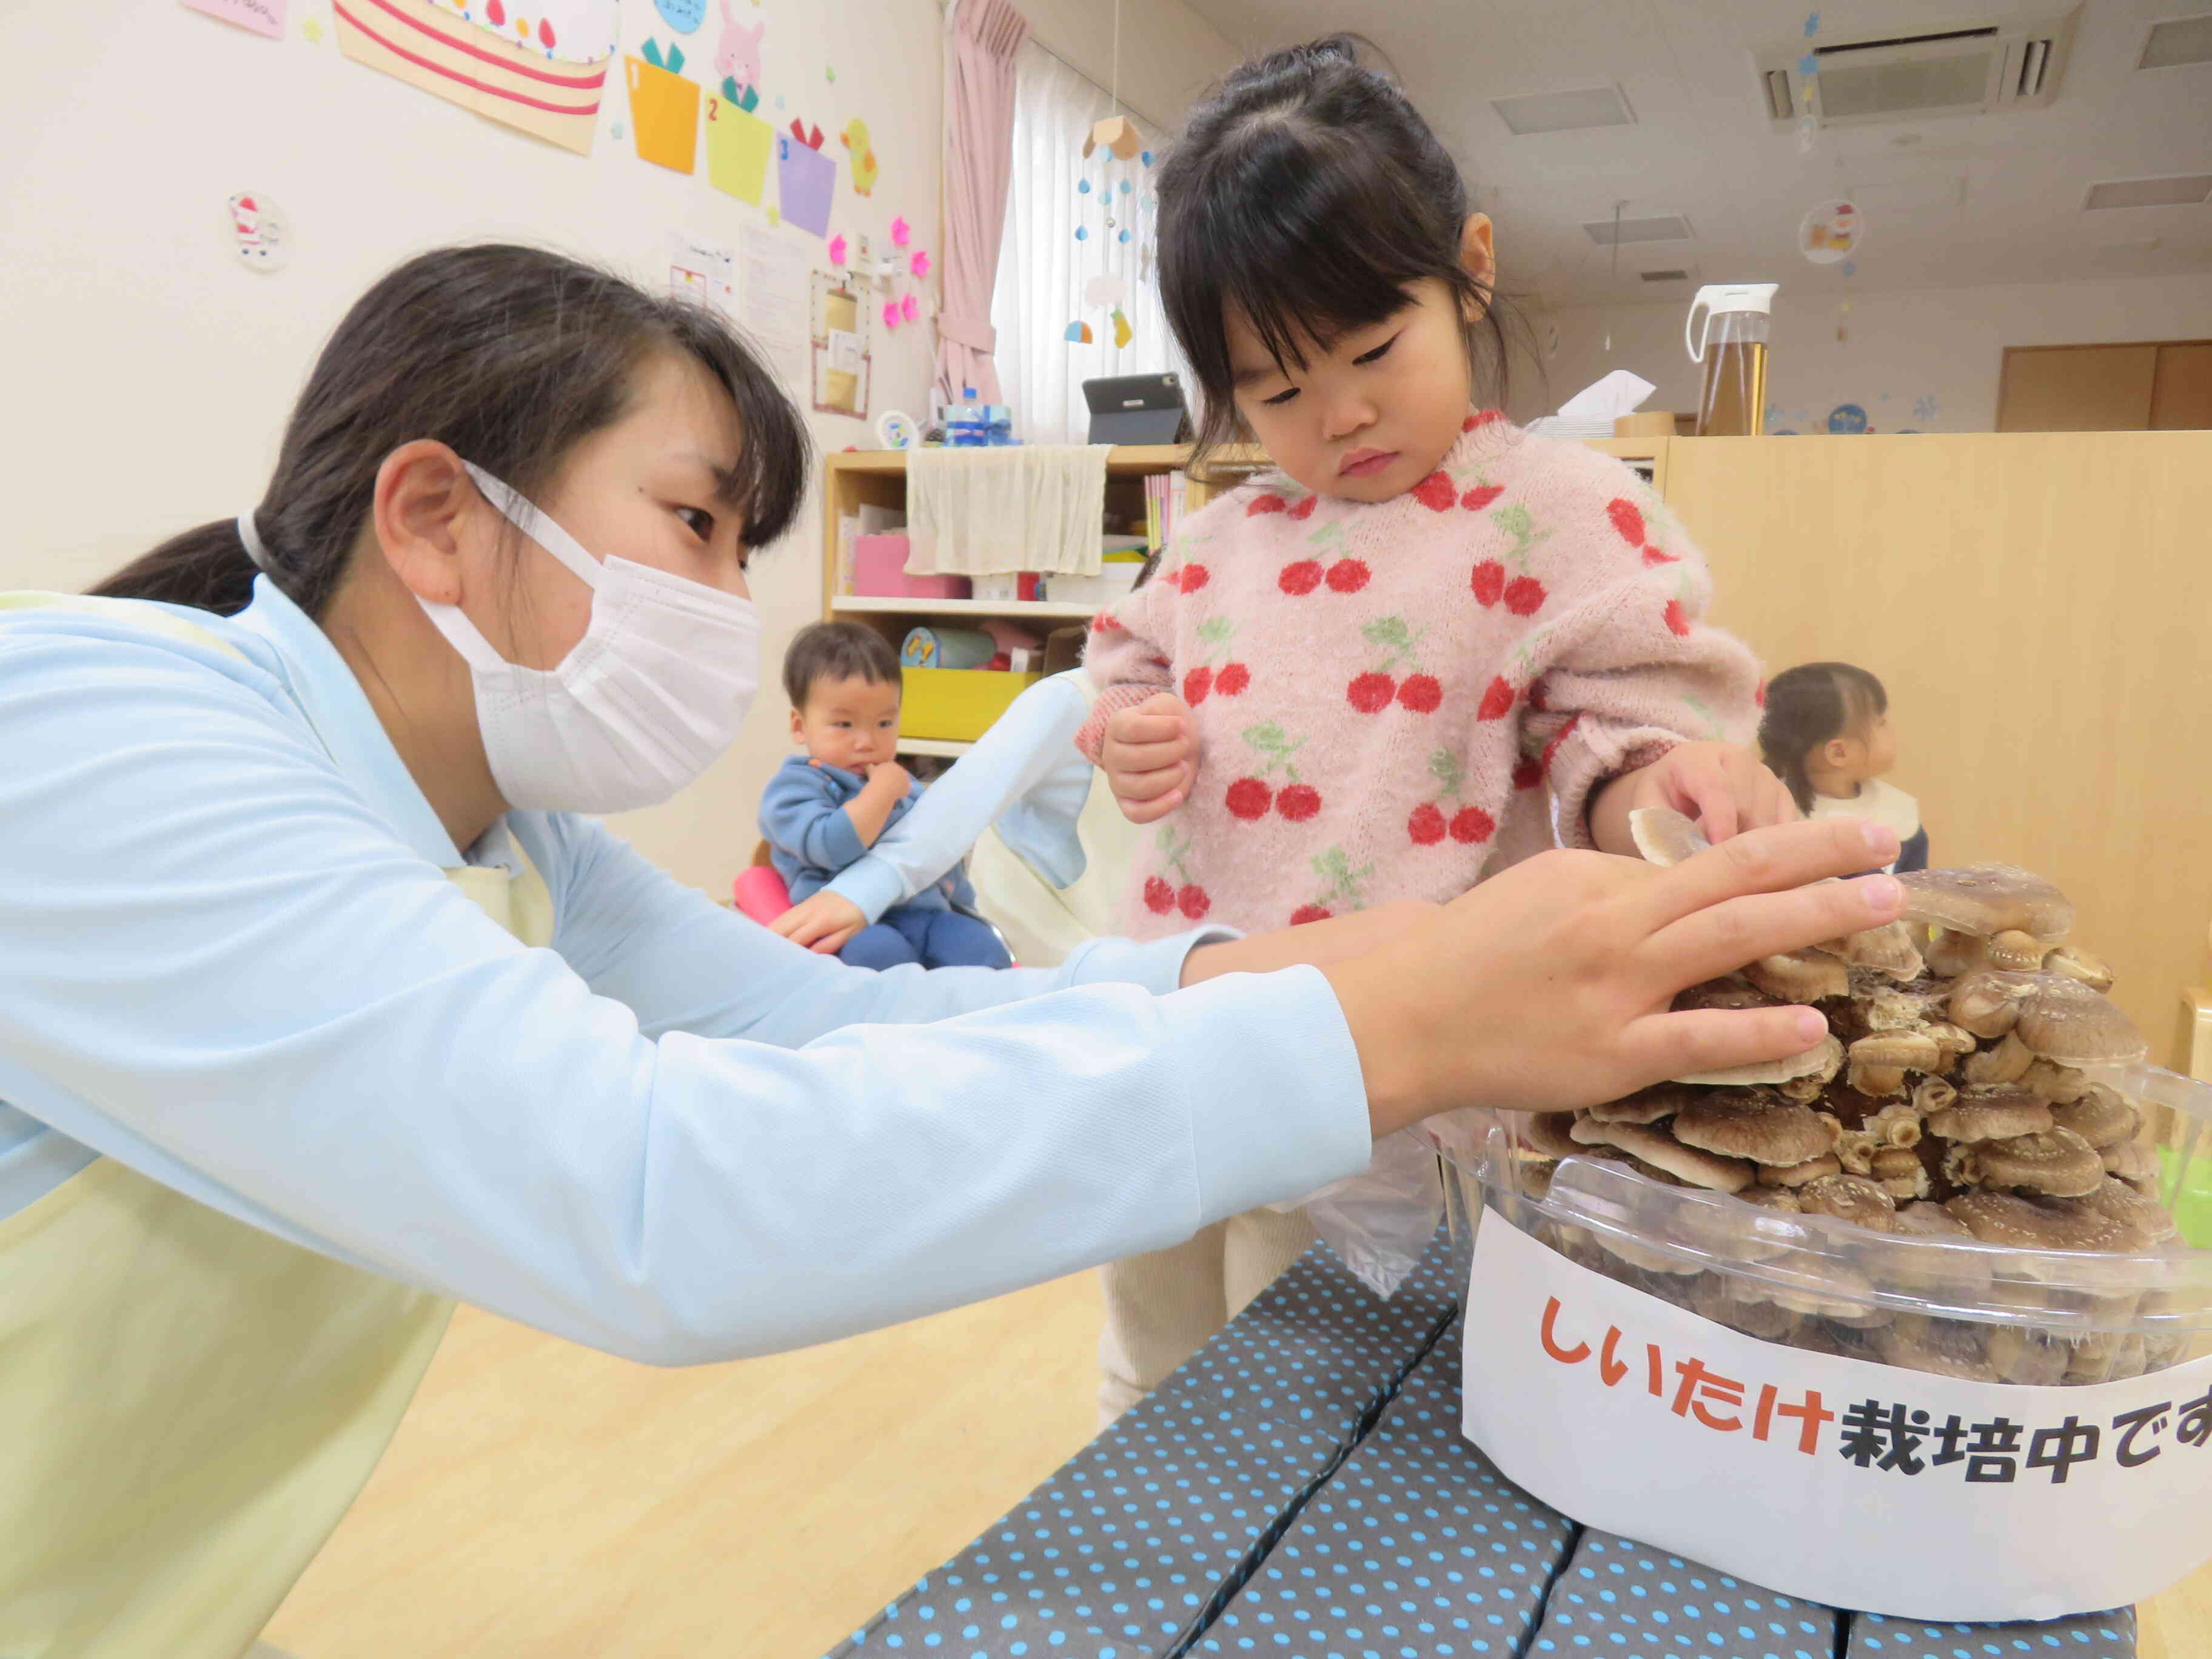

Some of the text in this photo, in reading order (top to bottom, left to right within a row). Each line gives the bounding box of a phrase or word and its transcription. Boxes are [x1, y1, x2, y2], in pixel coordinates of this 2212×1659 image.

[631, 63, 640, 89] 1
[708, 98, 718, 121] 2
[780, 138, 789, 161] 3
